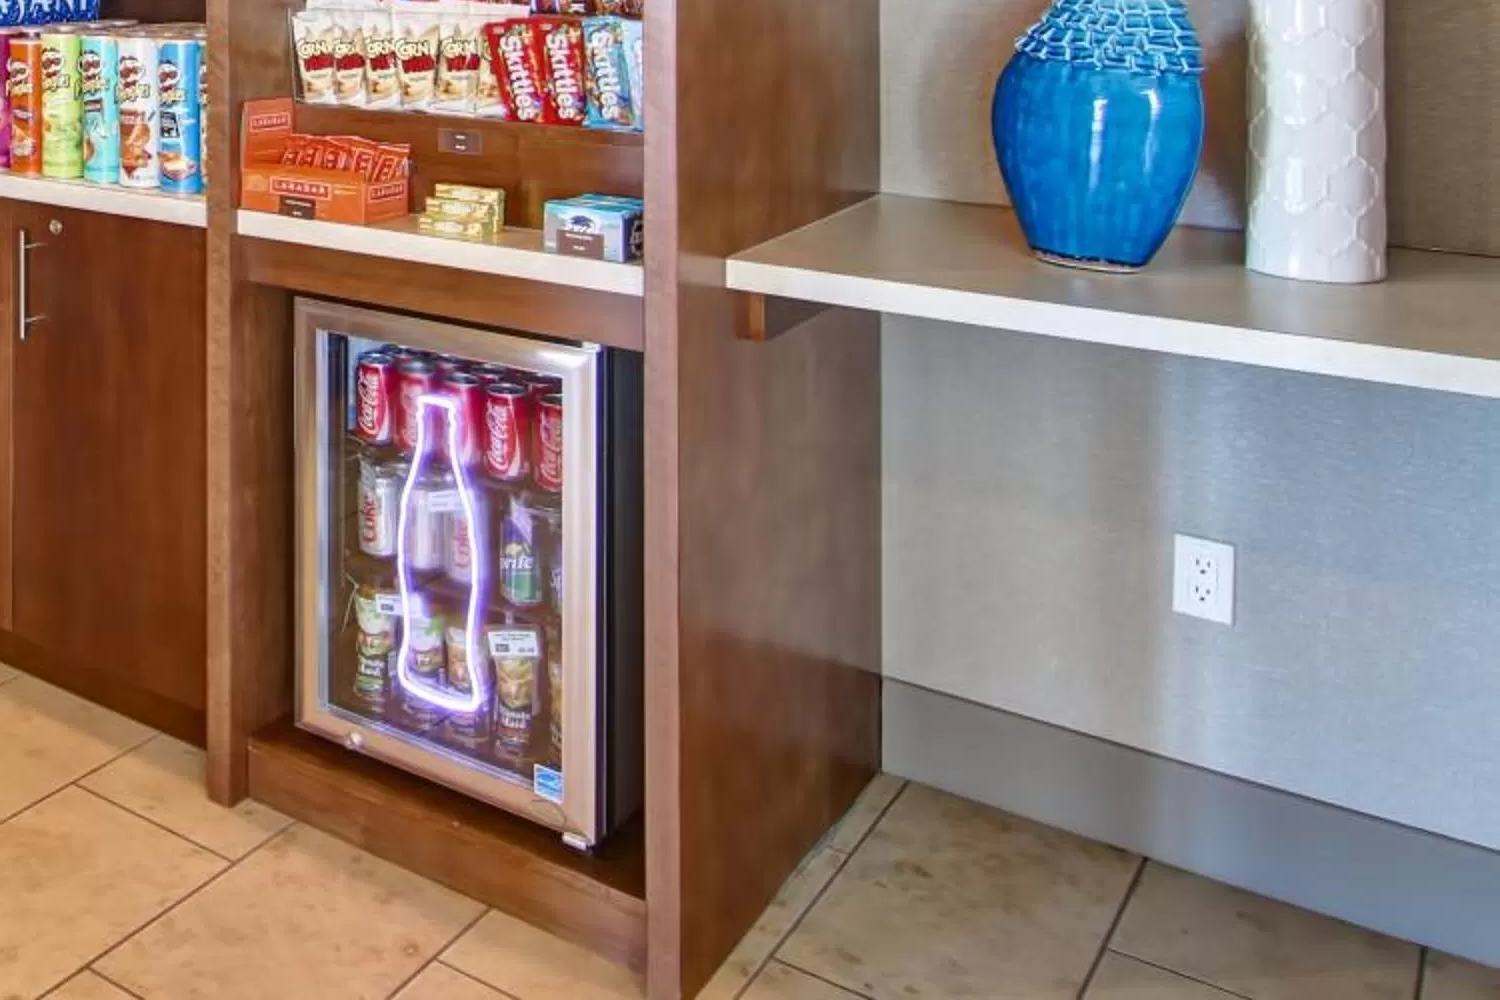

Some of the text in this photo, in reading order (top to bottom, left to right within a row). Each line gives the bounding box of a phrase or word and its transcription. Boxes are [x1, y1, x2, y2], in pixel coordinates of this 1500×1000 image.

[500, 35, 538, 121] Skittles
[546, 33, 580, 120] Skittles
[589, 30, 621, 120] Skittles
[486, 398, 509, 470] Coca-Cola
